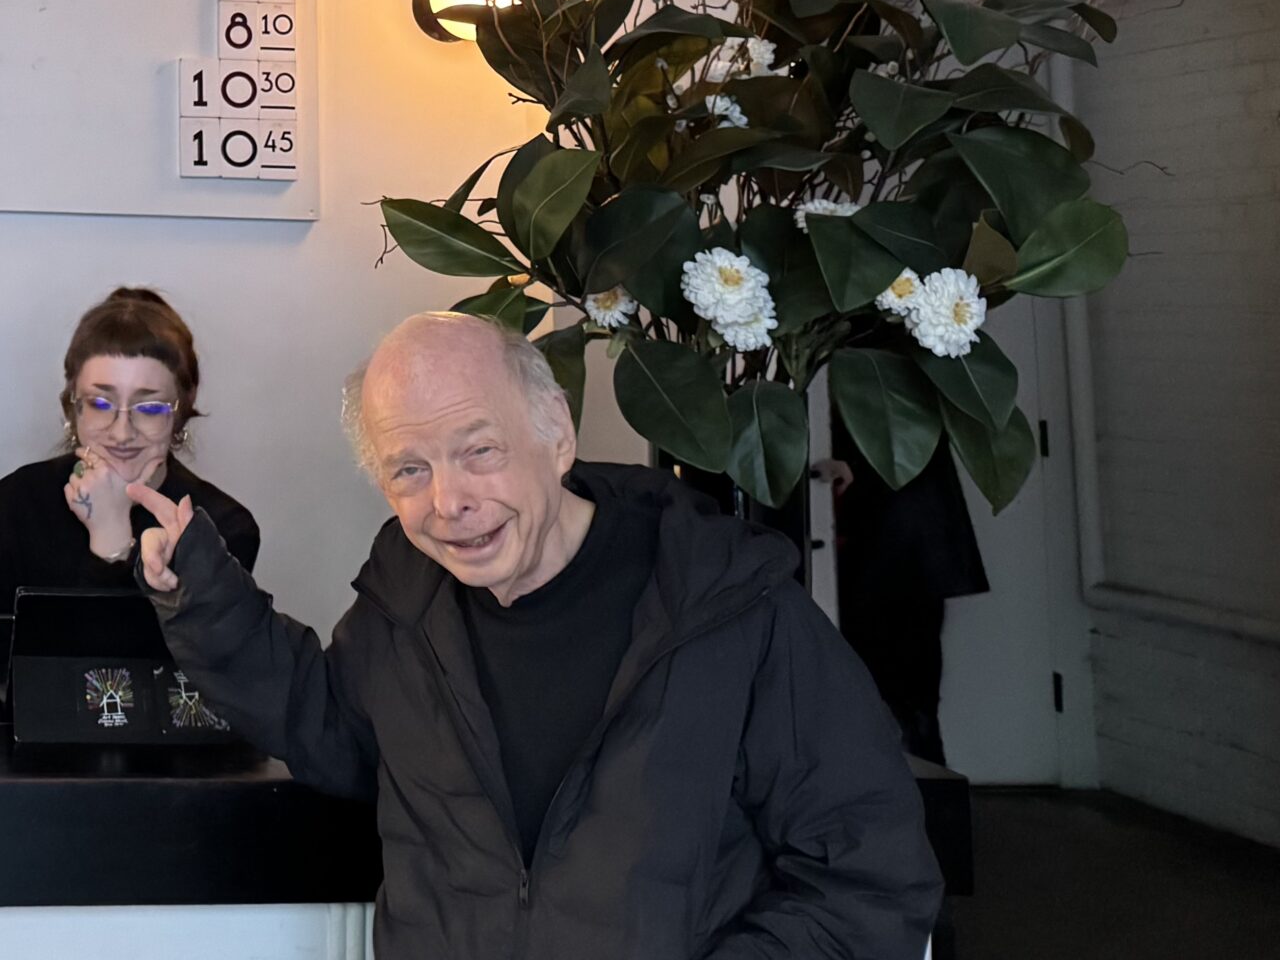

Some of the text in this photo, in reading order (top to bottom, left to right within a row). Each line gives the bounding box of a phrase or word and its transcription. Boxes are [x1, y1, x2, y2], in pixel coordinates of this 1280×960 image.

[225, 12, 293, 49] 8 10
[192, 69, 295, 109] 10 30
[192, 129, 294, 167] 10 45
